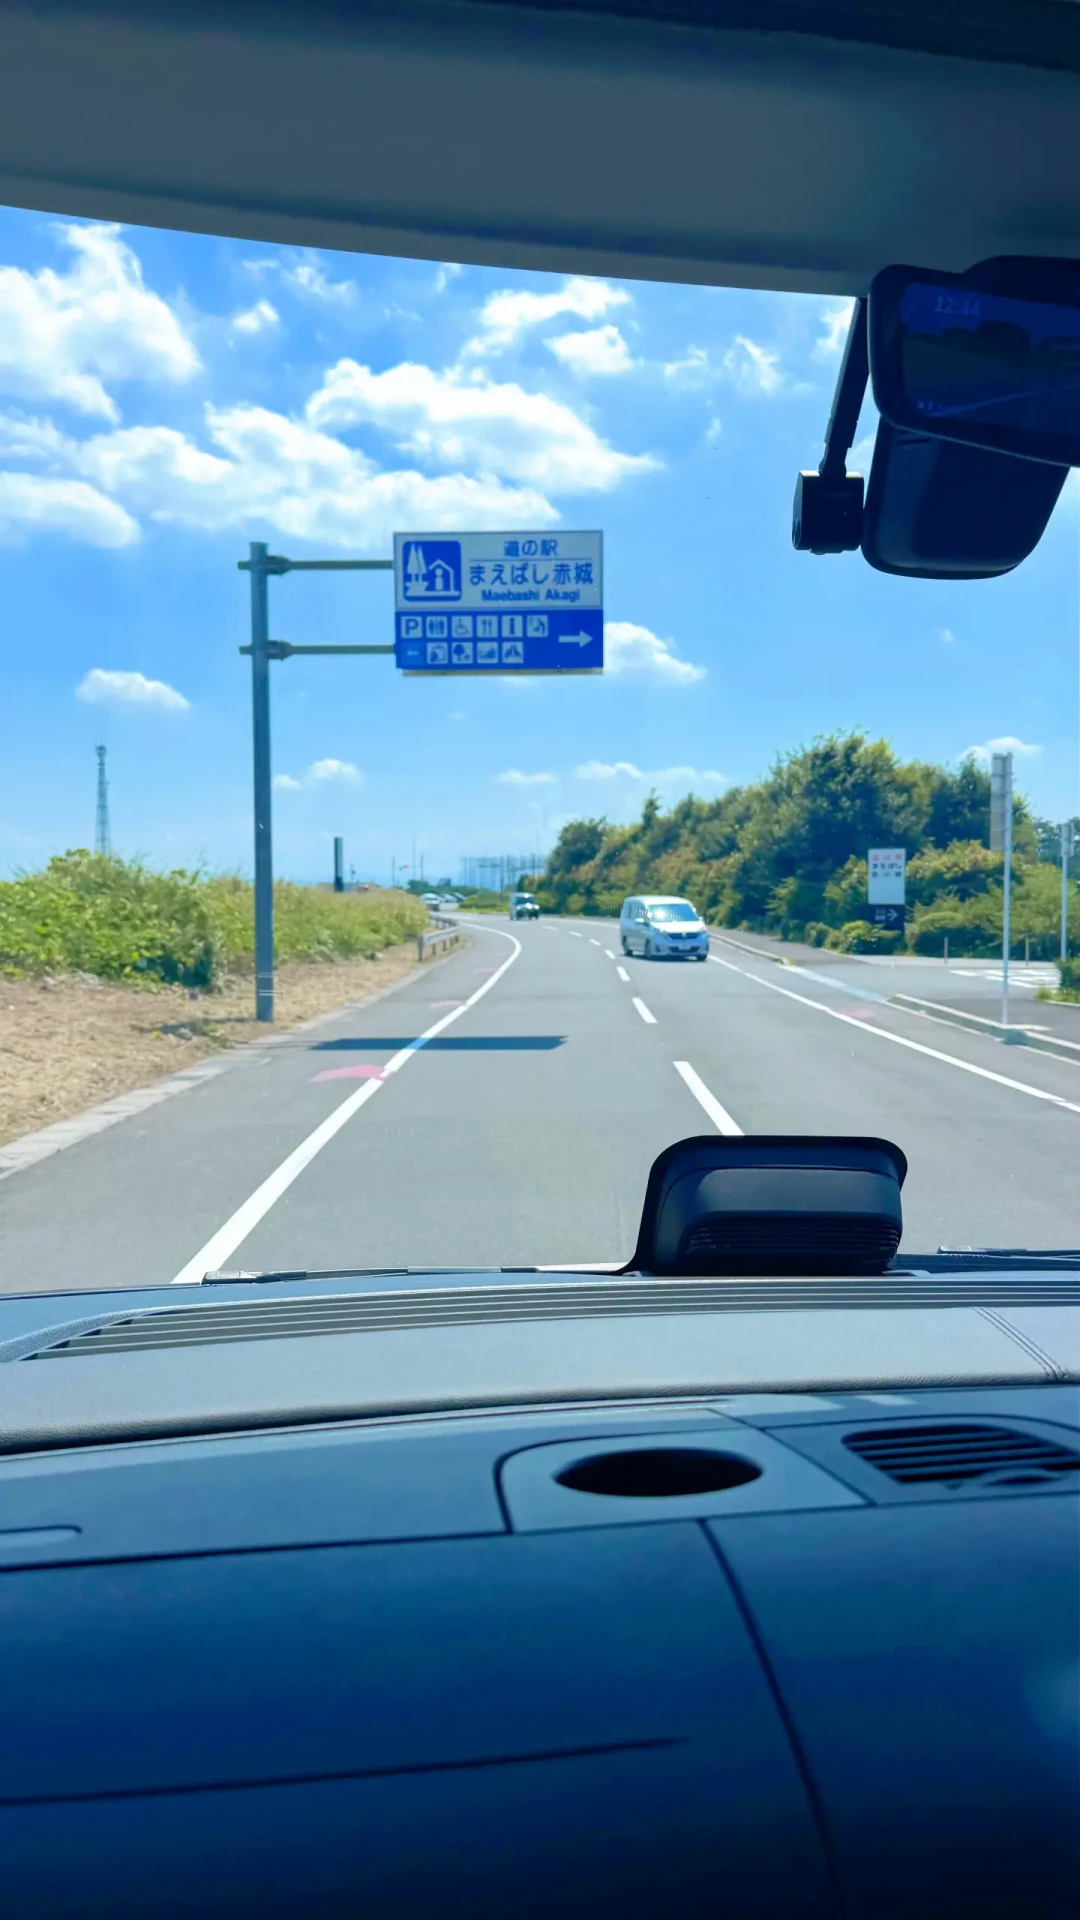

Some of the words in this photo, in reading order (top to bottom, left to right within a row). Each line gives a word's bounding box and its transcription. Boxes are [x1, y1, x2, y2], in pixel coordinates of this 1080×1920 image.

[504, 540, 558, 557] 道の駅
[469, 561, 593, 586] まえばし赤城
[482, 588, 539, 601] Maebashi
[545, 588, 580, 602] Akagi
[405, 619, 419, 636] P
